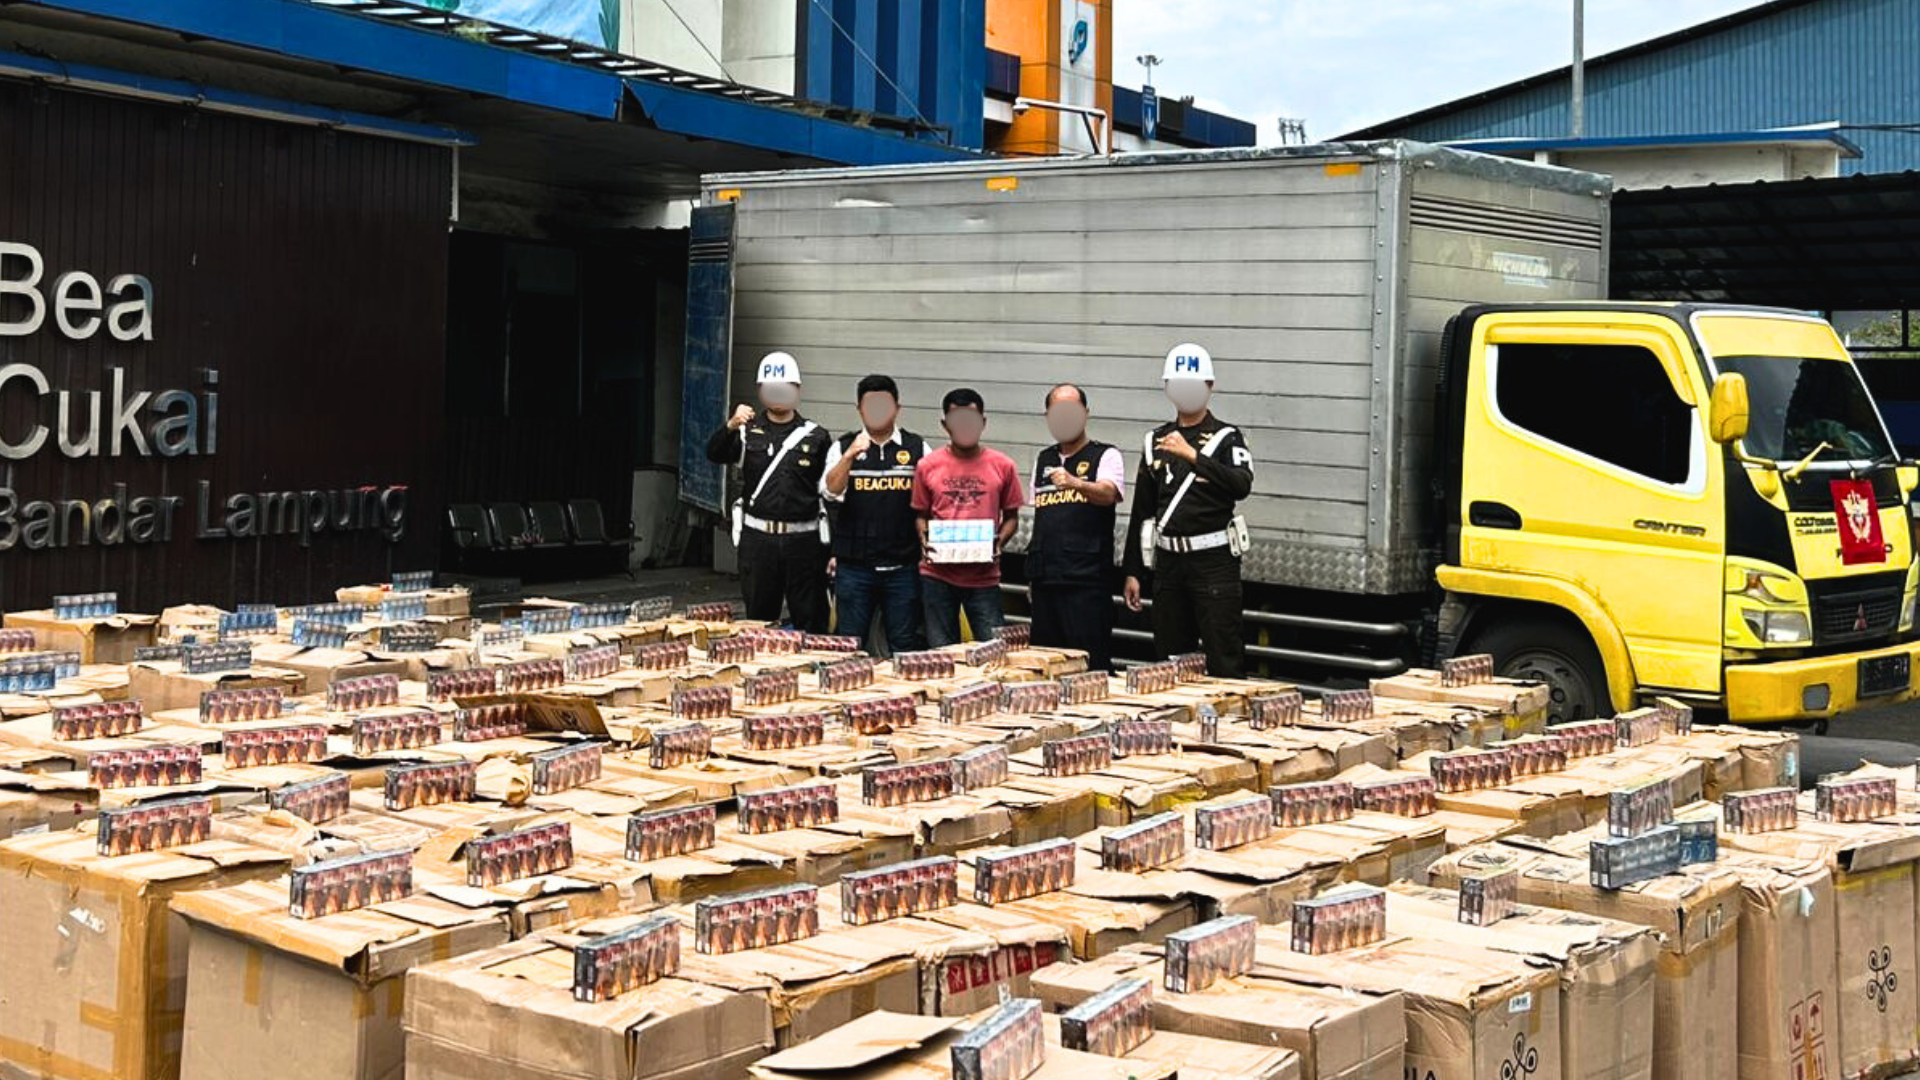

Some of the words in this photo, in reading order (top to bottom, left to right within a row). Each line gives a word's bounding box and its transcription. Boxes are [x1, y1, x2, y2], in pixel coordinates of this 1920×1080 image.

[0, 241, 153, 341] Bea
[763, 363, 785, 379] PM
[1175, 355, 1199, 373] PM
[0, 363, 218, 460] Cukai
[1231, 445, 1254, 473] P
[854, 477, 912, 491] BEACUKA
[1035, 489, 1088, 508] BEACUKA
[0, 482, 183, 550] Bandar
[197, 480, 409, 547] Lampung
